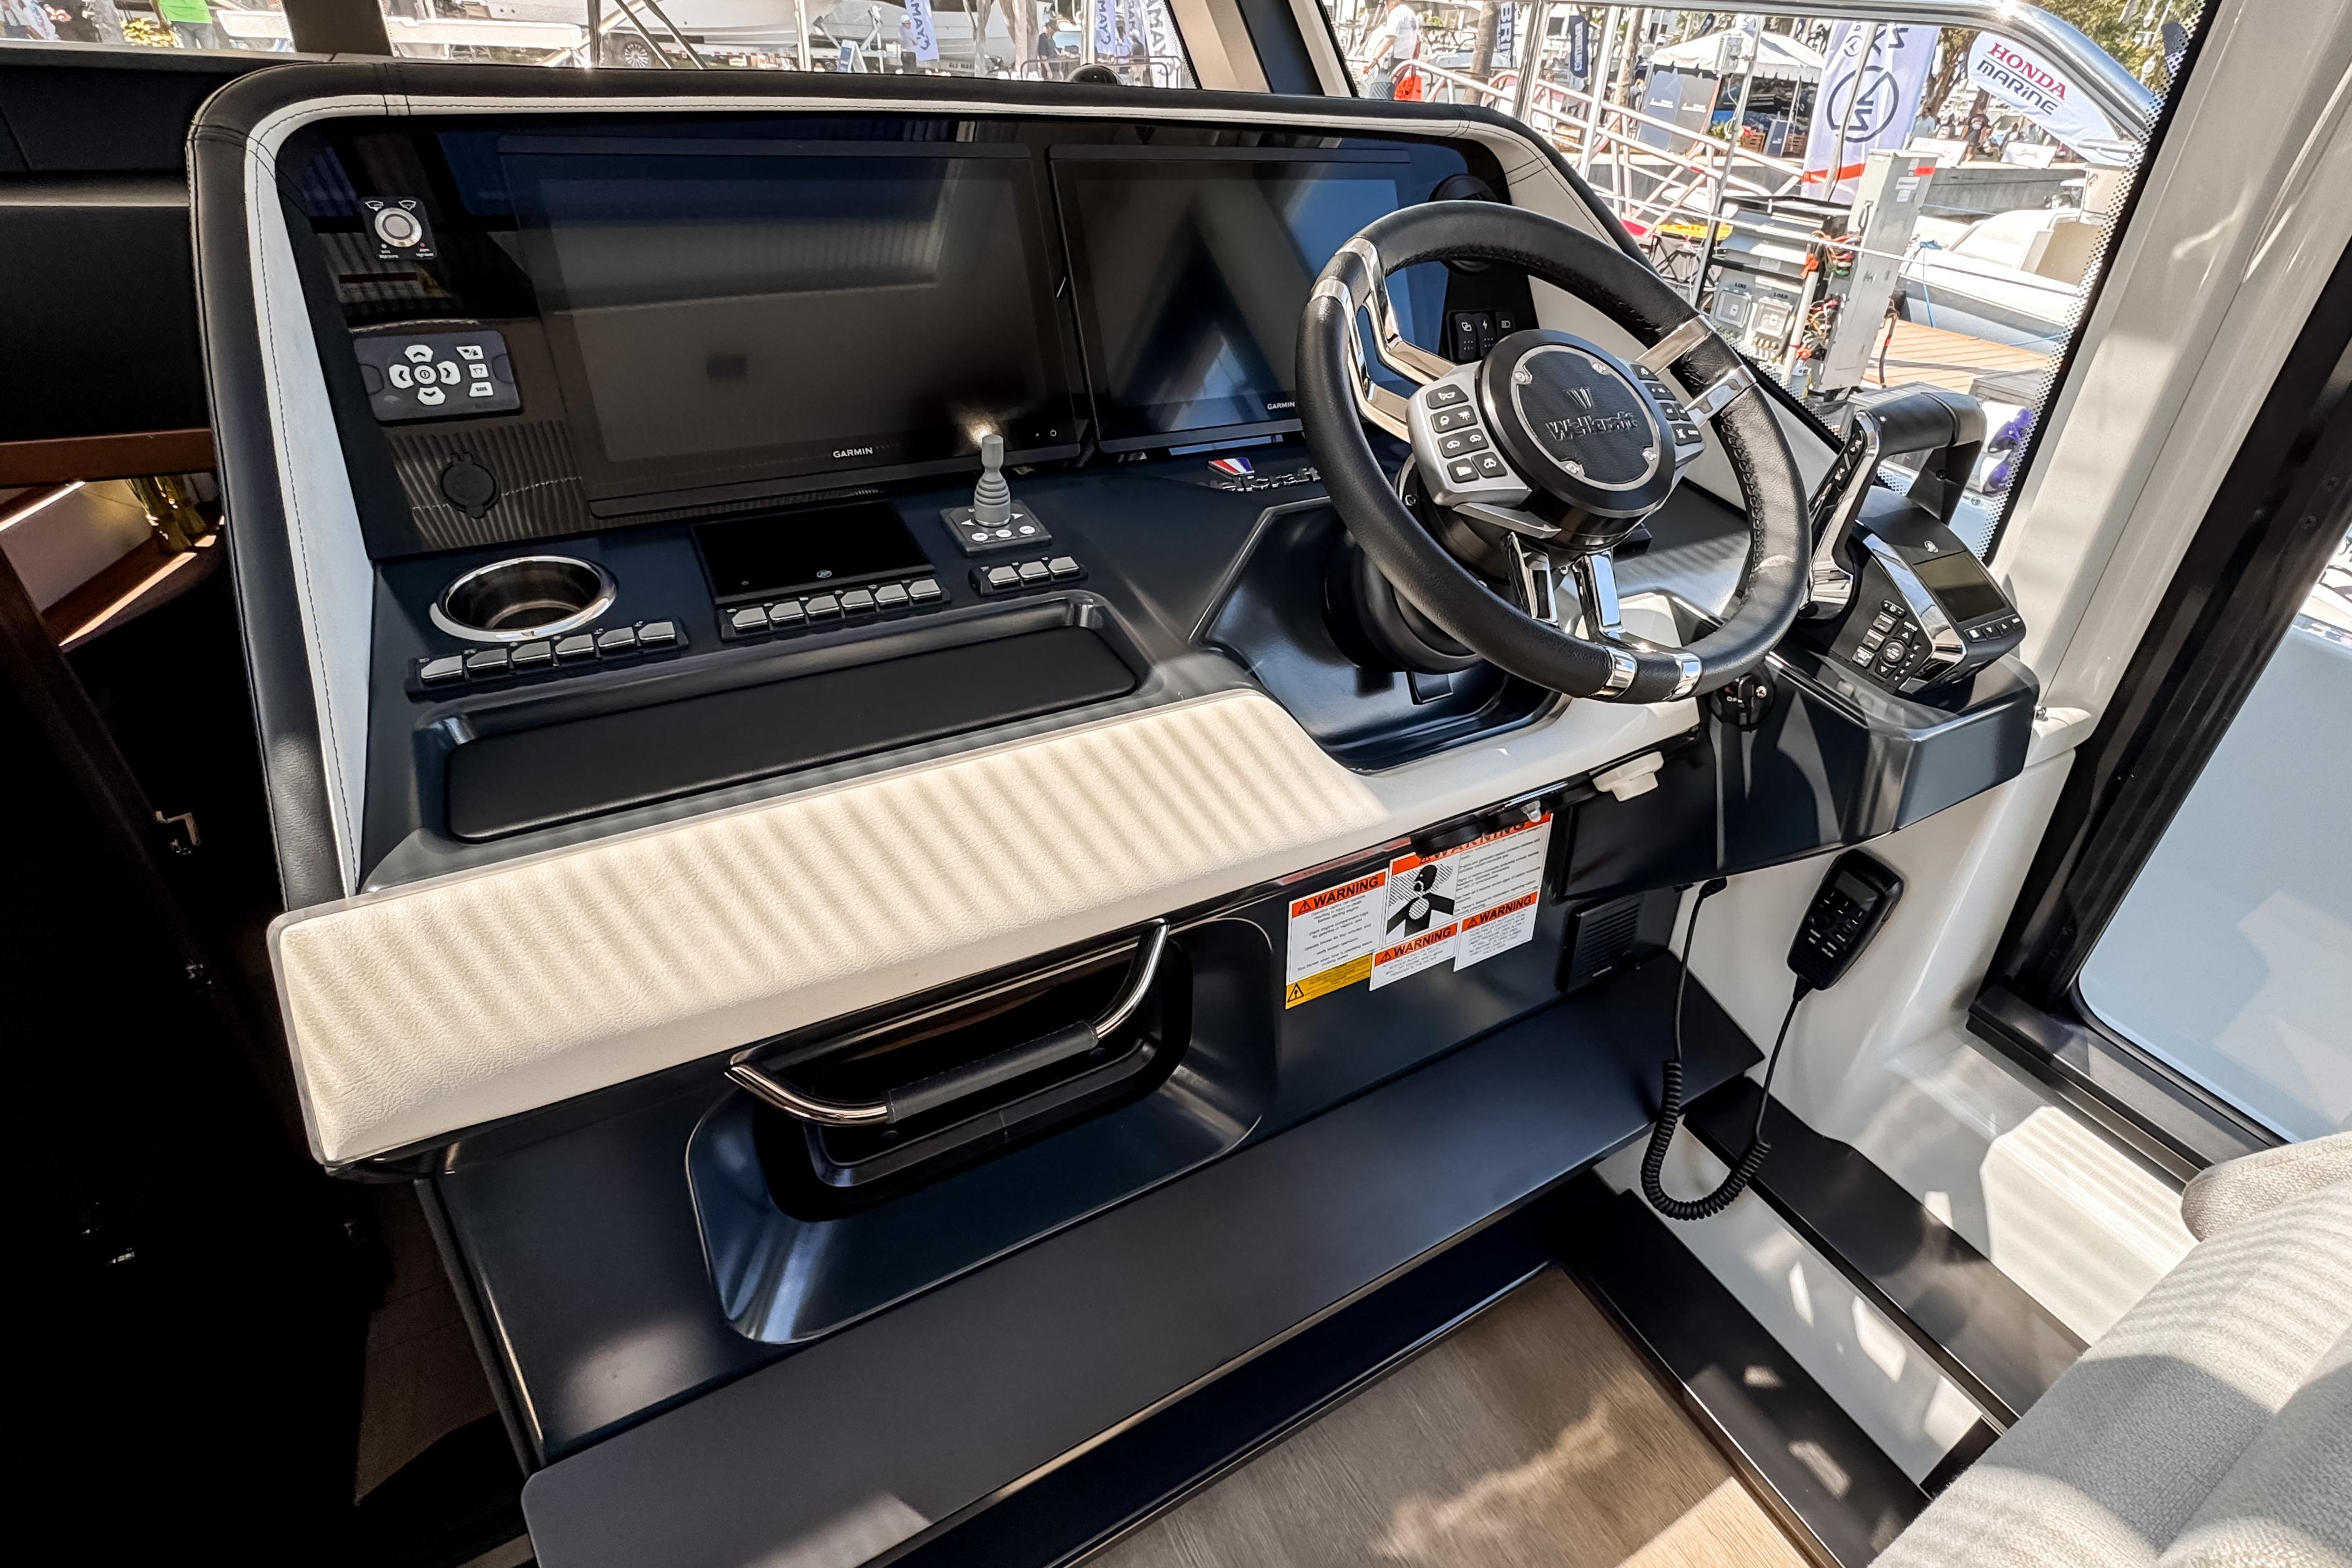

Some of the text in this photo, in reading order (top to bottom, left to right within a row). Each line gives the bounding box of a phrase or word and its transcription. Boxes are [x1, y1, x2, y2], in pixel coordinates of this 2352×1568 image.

[1987, 42, 2067, 100] HONDA
[1976, 60, 2059, 115] MARINE
[1267, 401, 1295, 410] GARMIN
[1546, 410, 1638, 441] Wellcraft
[833, 447, 873, 458] GARMIN
[1313, 876, 1379, 908] WARNING
[1479, 895, 1531, 924] WARNING
[1393, 928, 1451, 958] WARNING
